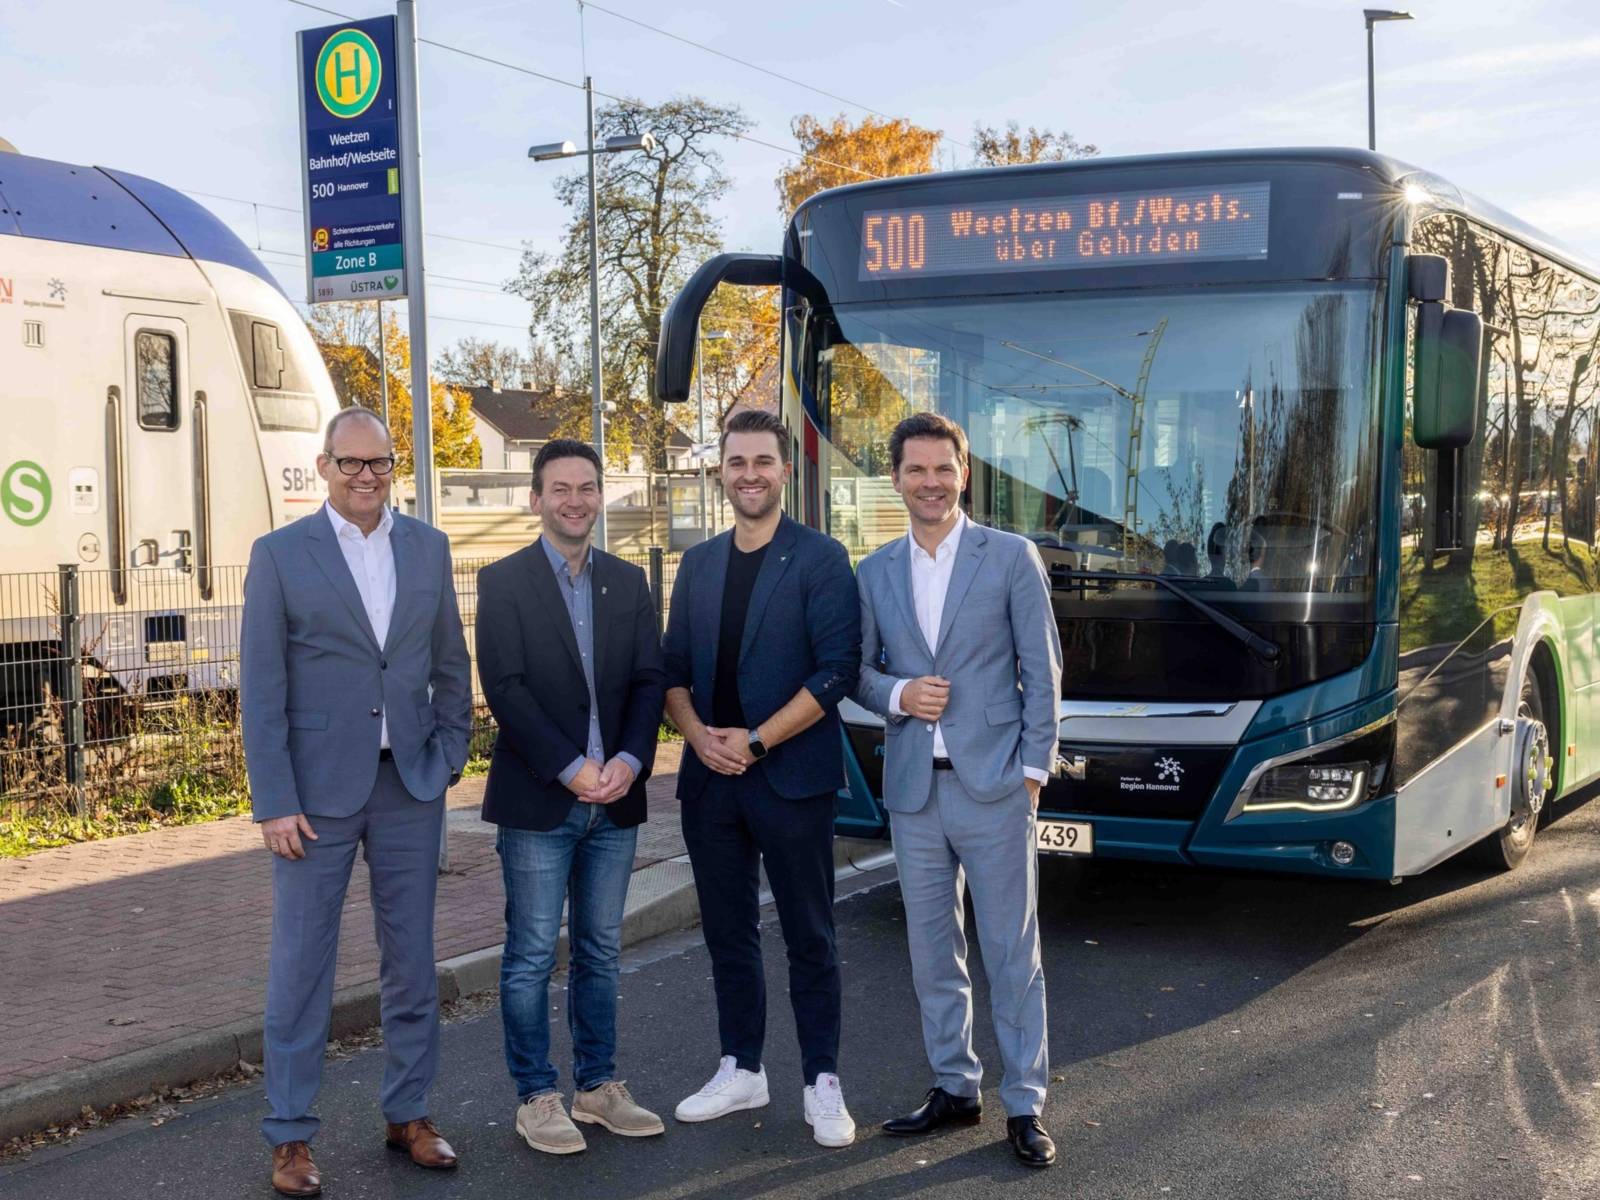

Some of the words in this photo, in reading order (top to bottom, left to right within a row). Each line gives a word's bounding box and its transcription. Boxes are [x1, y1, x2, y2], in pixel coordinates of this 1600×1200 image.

[334, 48, 361, 98] H
[329, 131, 370, 146] Weetzen
[309, 147, 396, 170] Bahnhof/Westseite
[312, 182, 335, 199] 500
[337, 181, 369, 192] Hannover
[951, 207, 1072, 236] Weetzen
[1088, 193, 1250, 228] Bf./Wests.
[332, 222, 396, 236] Schienenersatzverkehr
[333, 239, 344, 249] alle
[344, 238, 376, 249] Richtungen
[866, 214, 926, 272] 500
[996, 235, 1056, 260] über
[1078, 226, 1200, 256] Gehrden
[335, 255, 366, 270] Zone
[368, 252, 377, 266] B
[350, 280, 384, 293] ÜSTRA
[9, 466, 45, 520] S
[1120, 782, 1145, 791] Region
[1145, 783, 1180, 791] Hannover
[1040, 824, 1078, 847] 439
